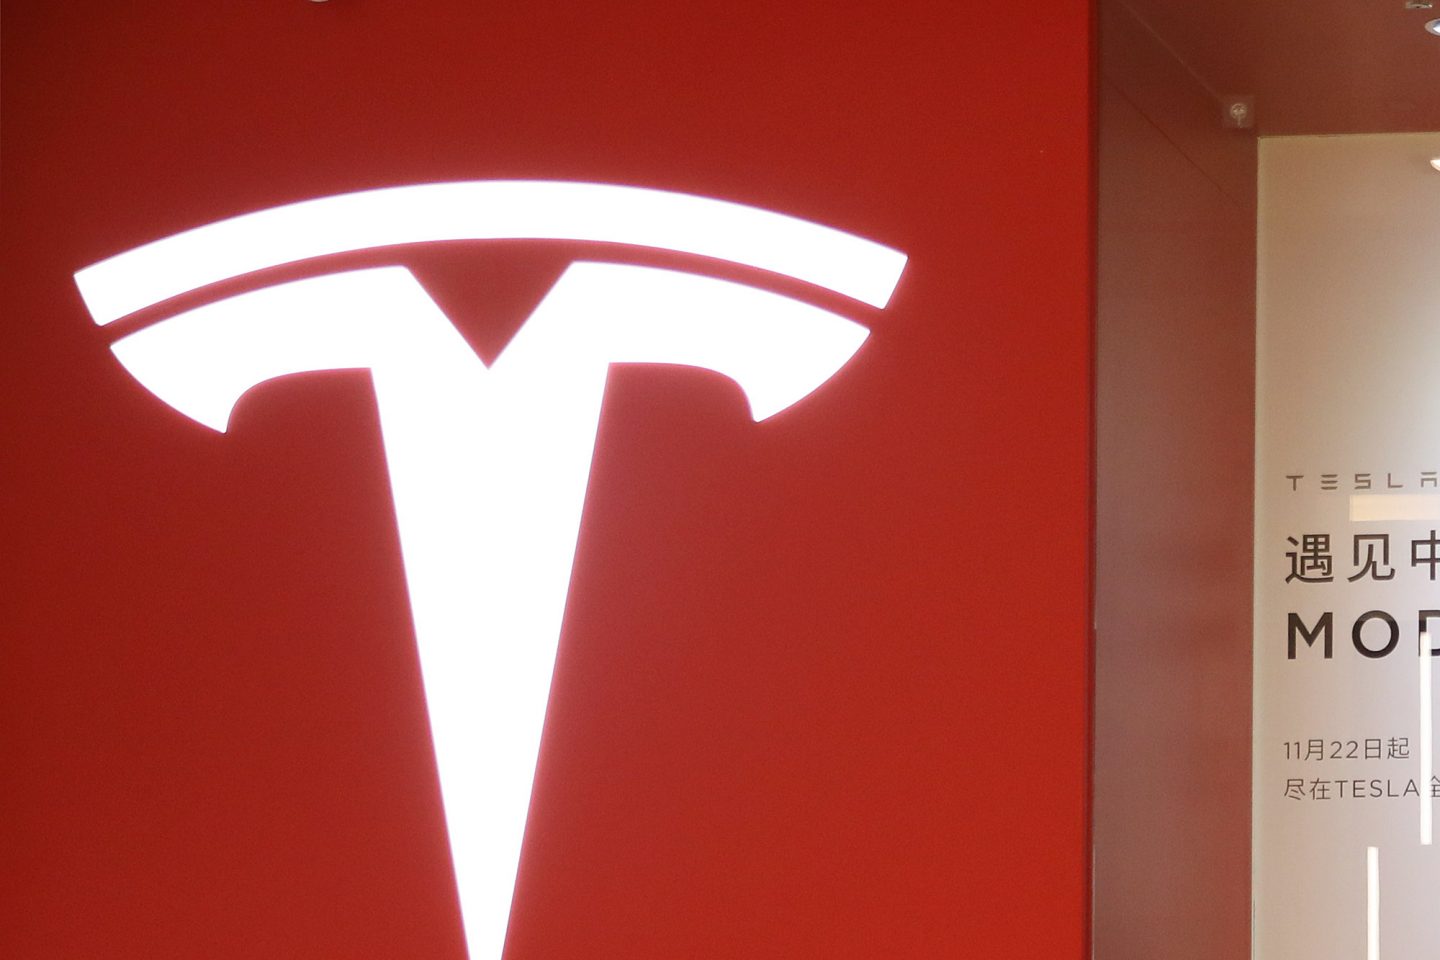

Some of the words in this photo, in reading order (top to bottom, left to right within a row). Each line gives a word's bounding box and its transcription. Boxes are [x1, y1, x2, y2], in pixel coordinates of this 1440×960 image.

[1285, 471, 1439, 492] TESLA
[1283, 736, 1410, 761] 11月22日起
